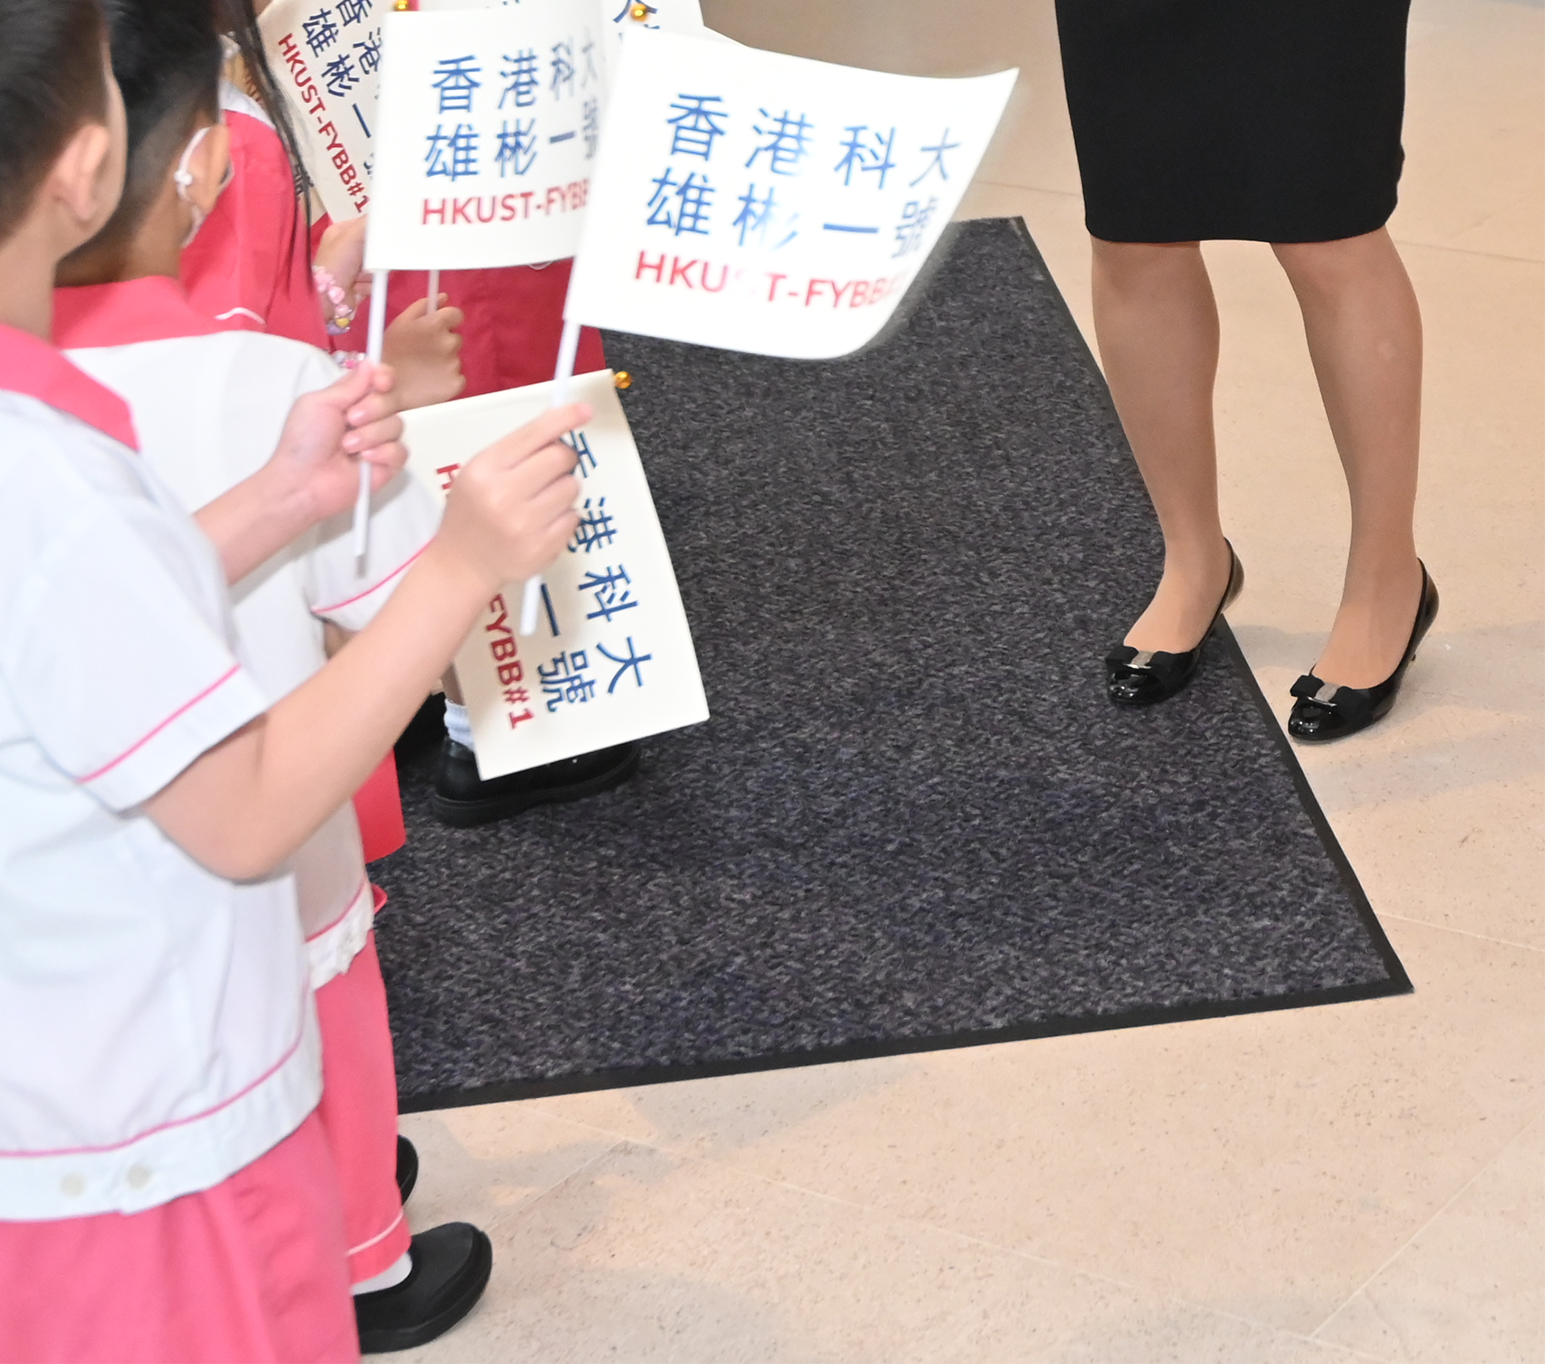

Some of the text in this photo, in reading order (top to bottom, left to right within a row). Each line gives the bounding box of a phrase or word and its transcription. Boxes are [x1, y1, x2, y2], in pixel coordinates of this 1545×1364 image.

[278, 32, 371, 214] HKUST-FYBB#1
[301, 7, 375, 182] 雄彬一
[667, 93, 961, 189] 香港科大
[647, 168, 939, 259] 雄彬一號
